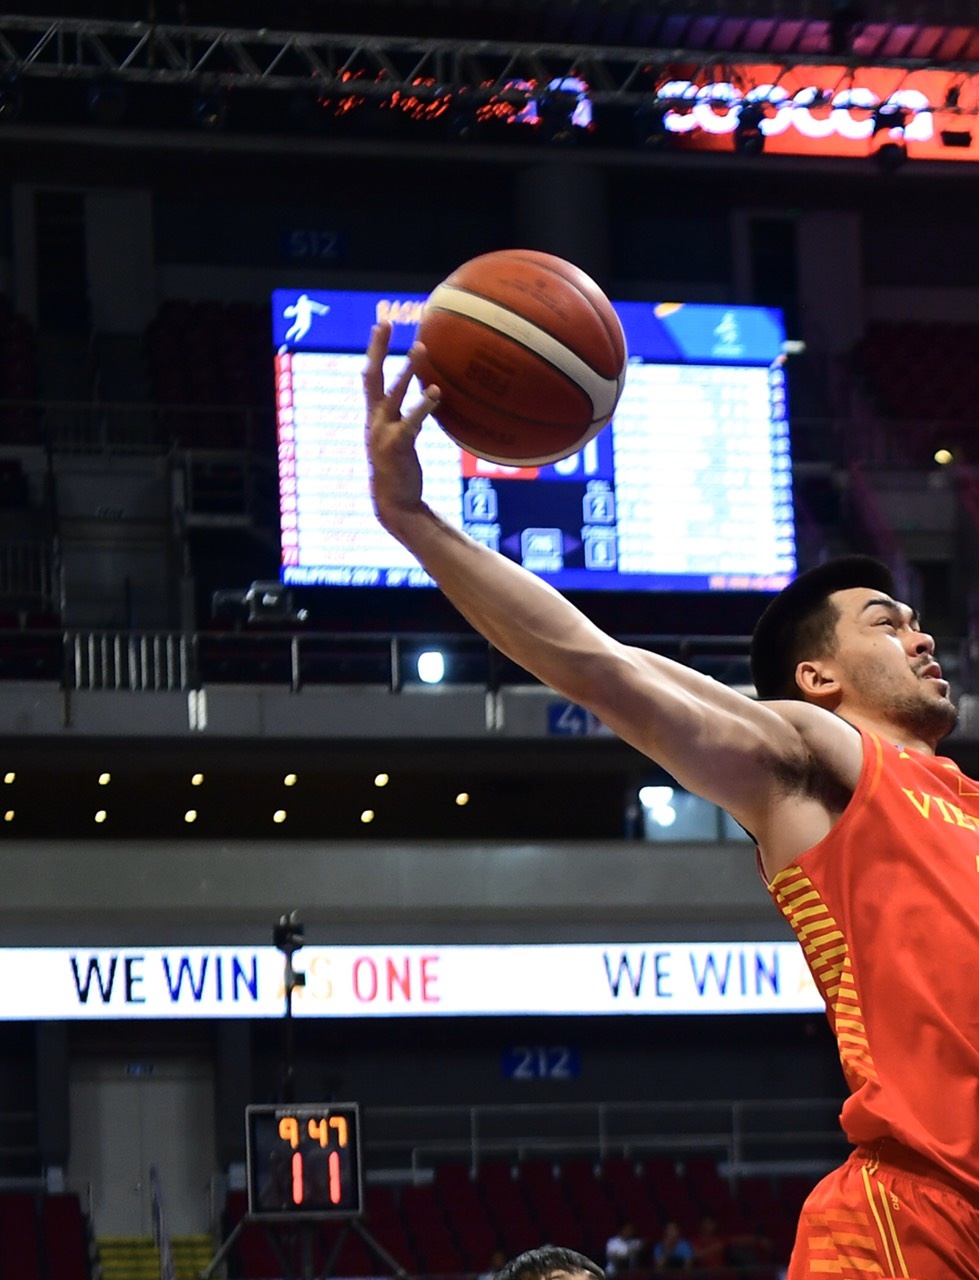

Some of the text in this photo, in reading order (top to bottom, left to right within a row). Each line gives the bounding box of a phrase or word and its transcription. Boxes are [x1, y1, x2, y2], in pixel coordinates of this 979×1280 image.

[70, 955, 146, 1003] WE
[162, 954, 259, 1002] WIN
[352, 955, 441, 1002] ONE
[603, 950, 781, 998] WE WIN
[513, 1045, 571, 1078] 212
